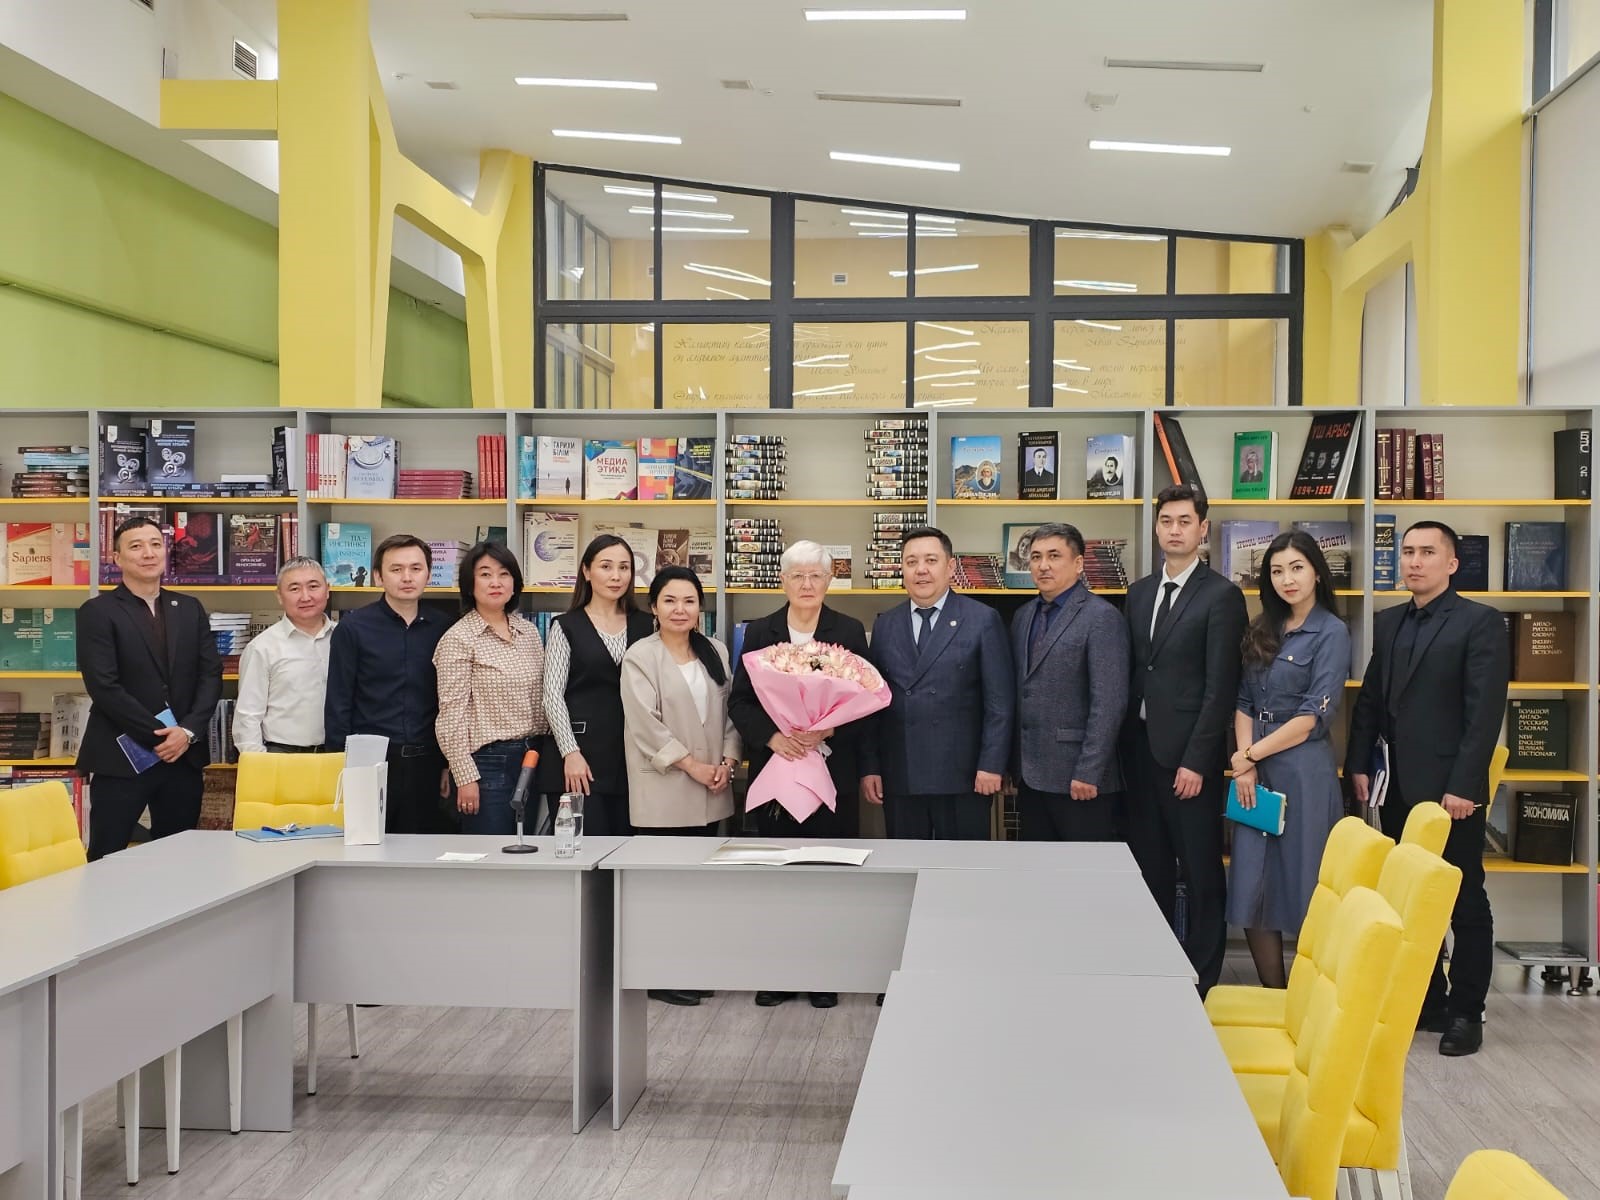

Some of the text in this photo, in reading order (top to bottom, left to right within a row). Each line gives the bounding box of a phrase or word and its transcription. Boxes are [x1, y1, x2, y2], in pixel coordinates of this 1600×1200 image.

[1325, 422, 1351, 438] АРЫС
[596, 457, 628, 466] МЕДИА
[12, 551, 52, 565] Sapiens
[1523, 805, 1570, 822] ЭКОНОМИКА
